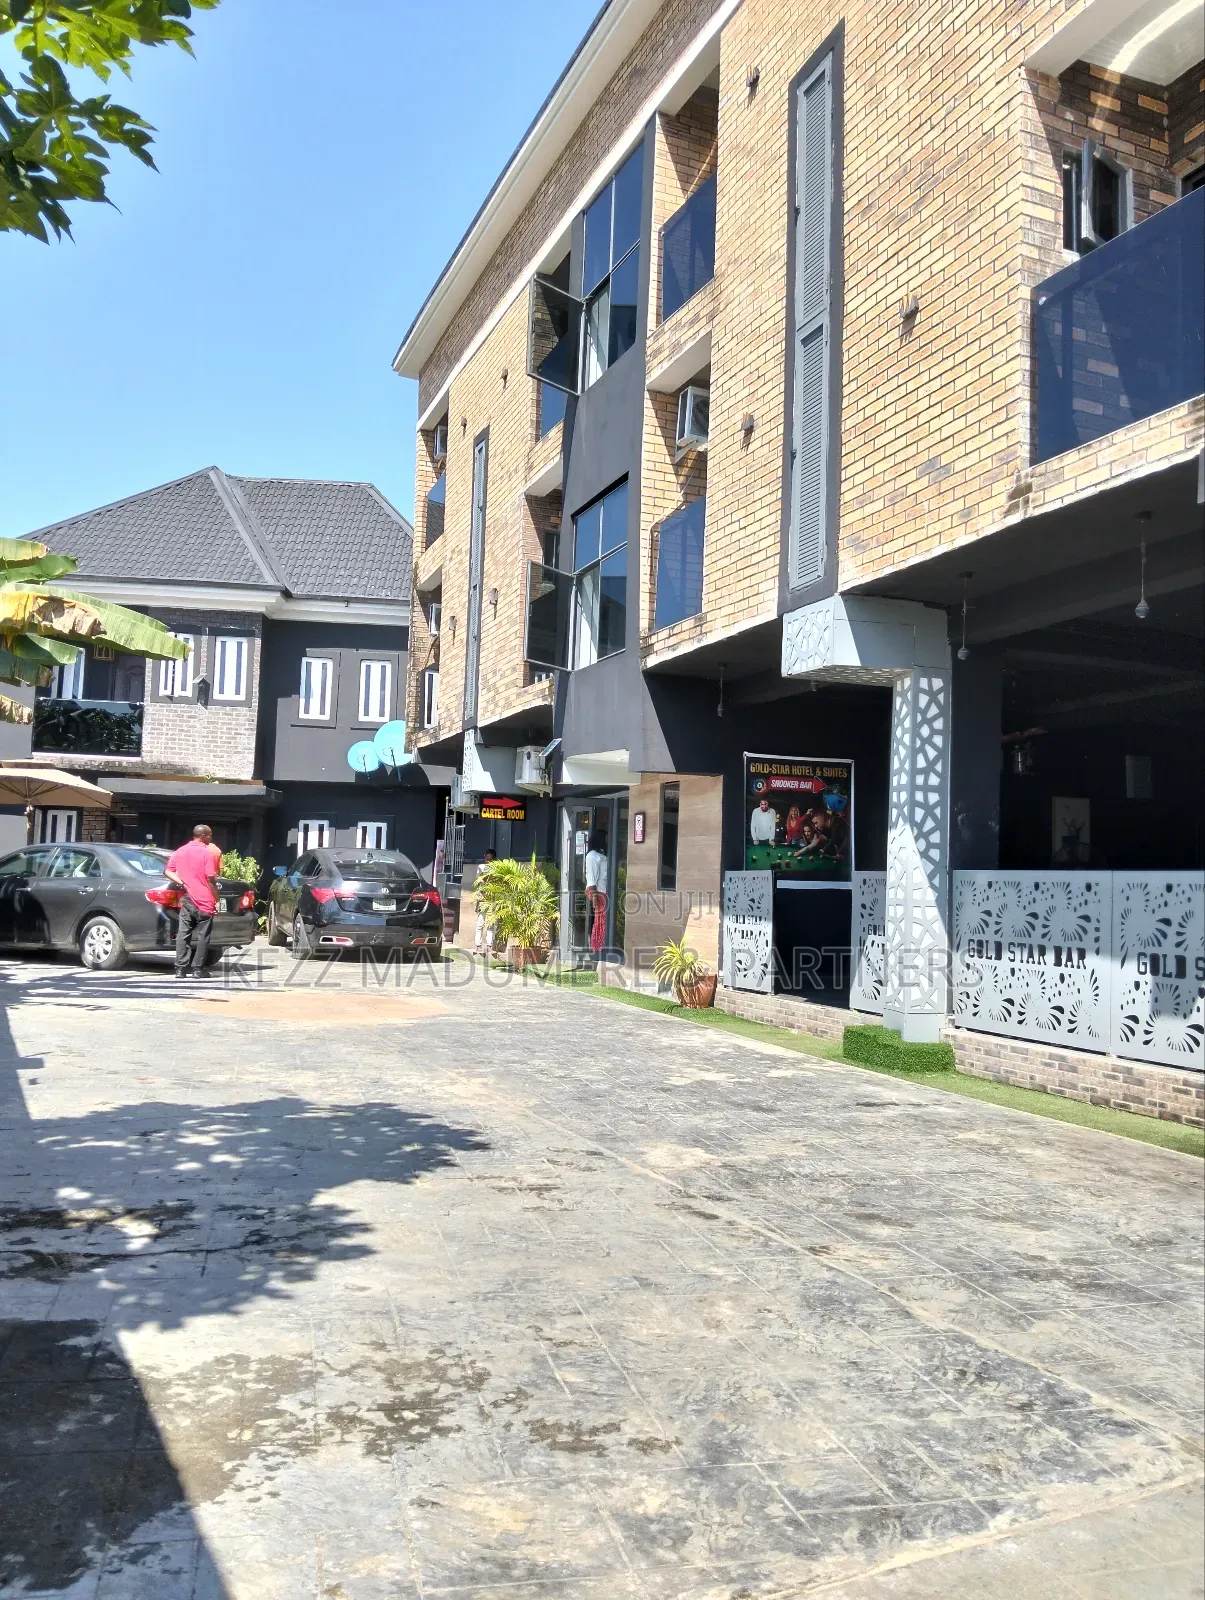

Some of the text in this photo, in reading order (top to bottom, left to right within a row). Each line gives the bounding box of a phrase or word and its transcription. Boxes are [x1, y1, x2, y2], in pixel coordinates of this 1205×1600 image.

[750, 763, 848, 778] GOLD-STAR HOTEL & SUITES
[771, 780, 812, 790] SNOOKER BAR
[481, 807, 525, 820] CARTEL ROOM
[741, 929, 754, 940] BAR
[967, 938, 1087, 970] GOLD STAR BAR
[1136, 951, 1187, 980] GOLD
